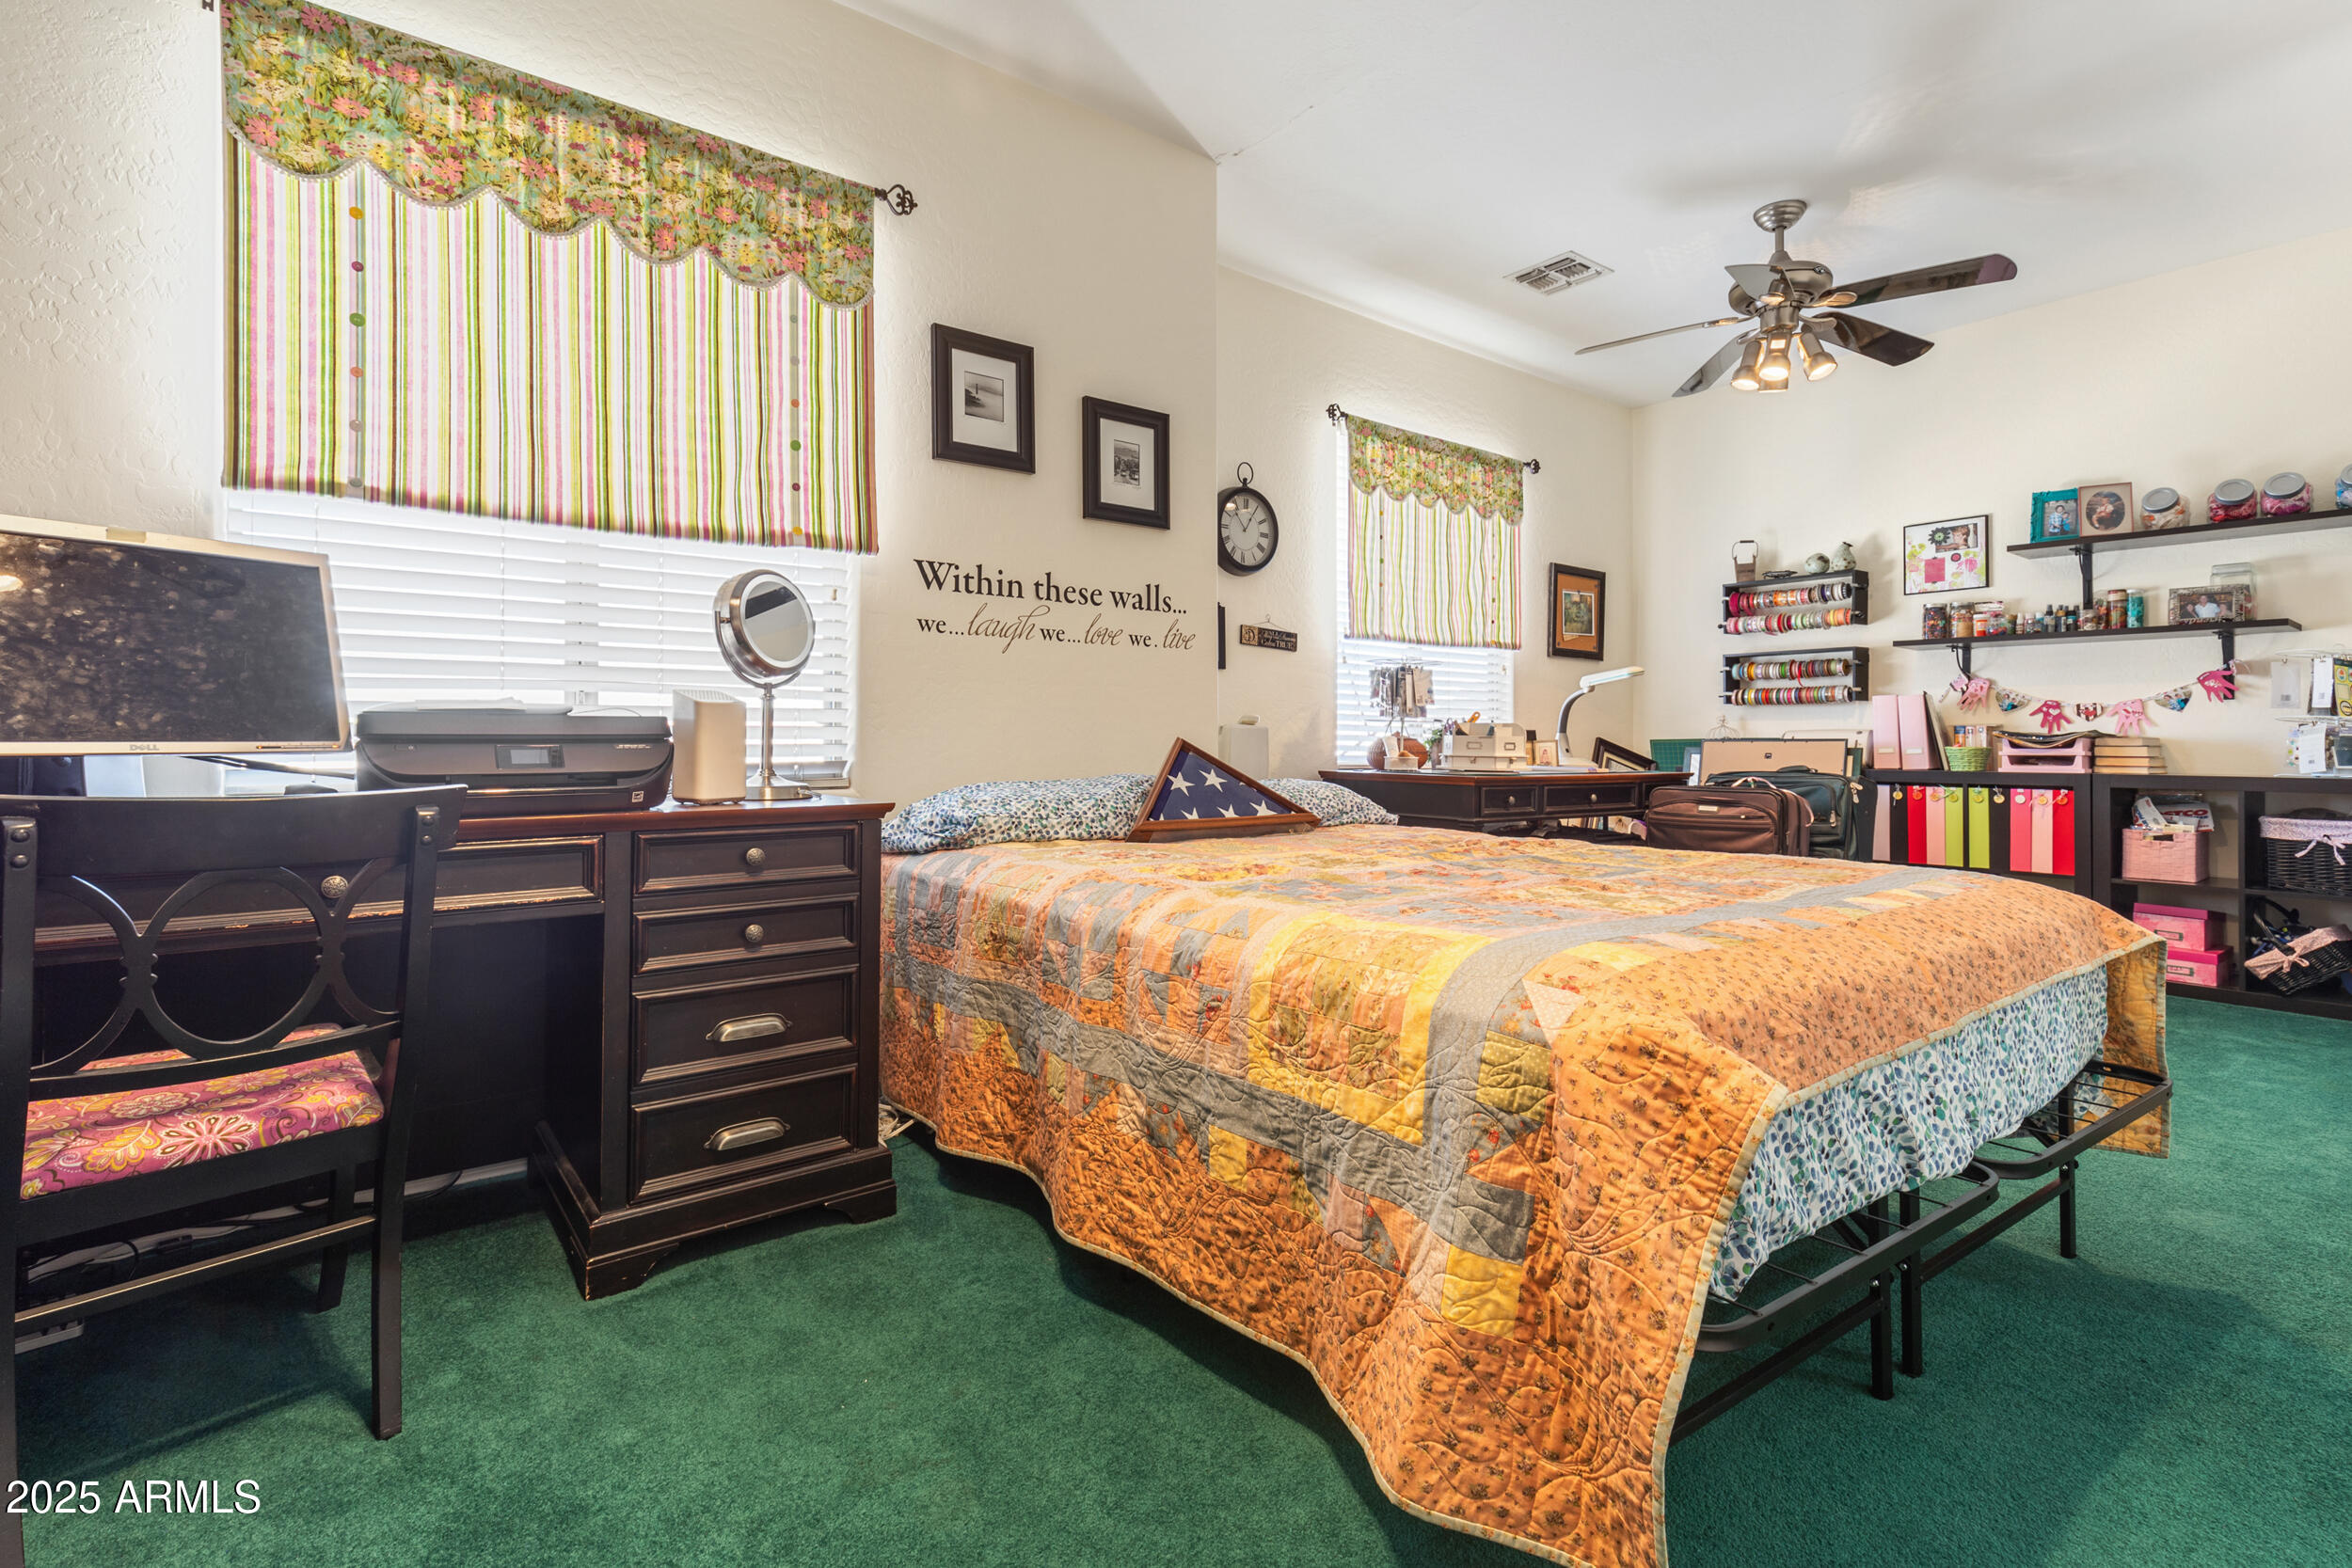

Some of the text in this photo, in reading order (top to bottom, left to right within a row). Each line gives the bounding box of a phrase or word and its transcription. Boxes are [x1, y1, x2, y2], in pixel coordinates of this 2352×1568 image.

[913, 558, 1187, 614] Within these walls...
[967, 602, 1051, 654] laugh
[1084, 612, 1123, 646] love
[1163, 618, 1196, 650] live
